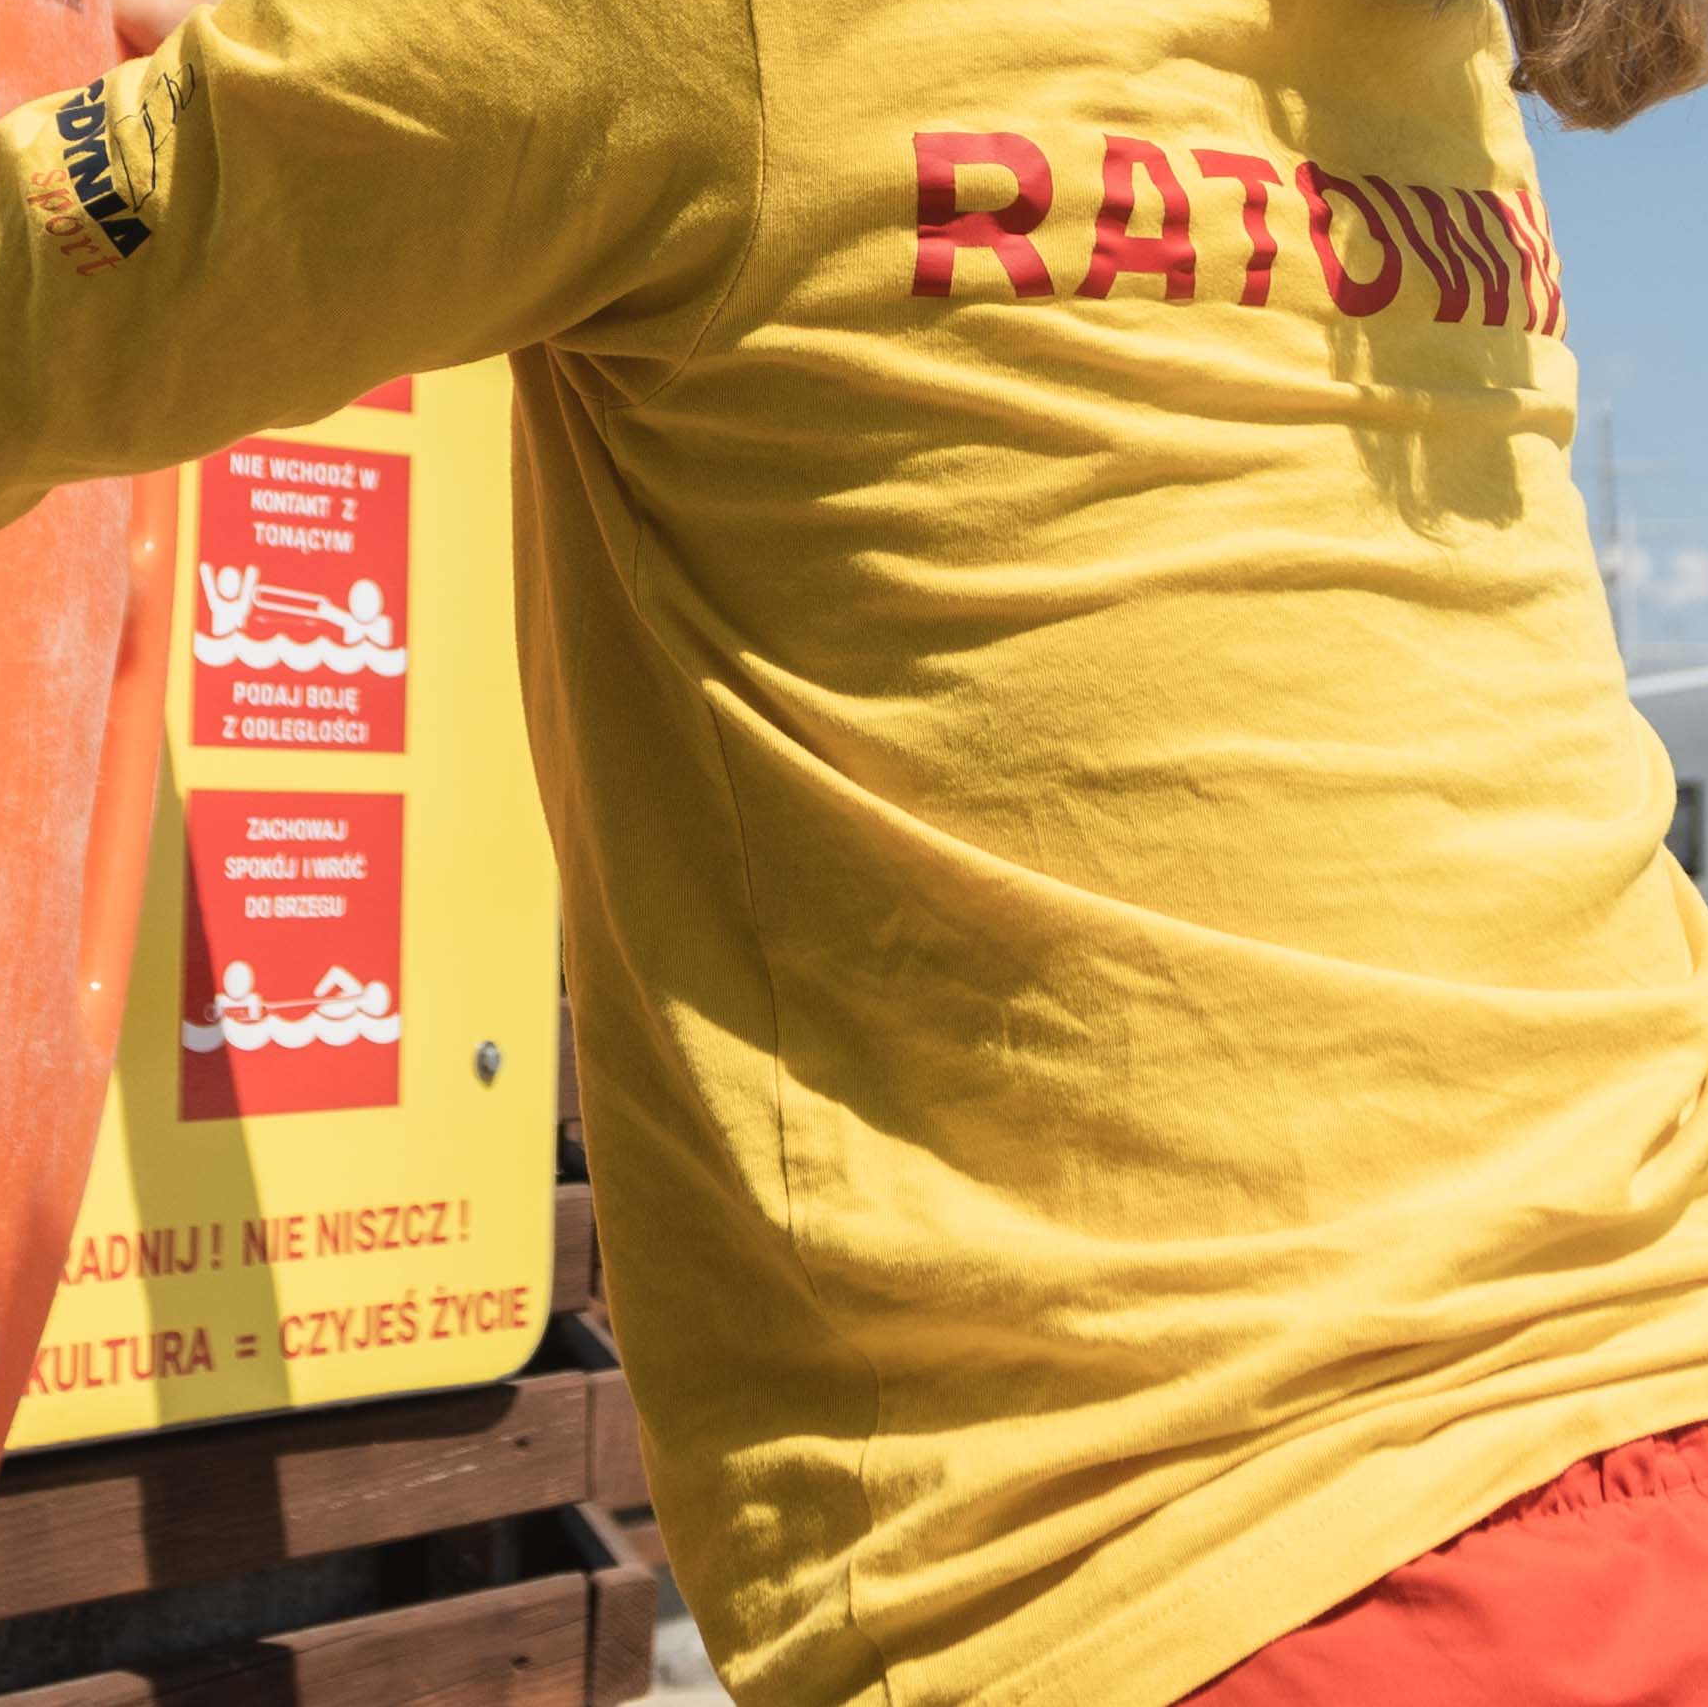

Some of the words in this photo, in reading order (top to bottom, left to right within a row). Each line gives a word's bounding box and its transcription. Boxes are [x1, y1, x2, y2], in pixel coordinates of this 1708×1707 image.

[26, 168, 122, 277] sport
[911, 130, 1566, 342] RATOWN
[229, 452, 265, 479] NIE
[269, 454, 356, 491] WCHODŹ
[359, 466, 380, 491] W
[250, 488, 331, 520] KONTAKT
[341, 496, 358, 522] Z
[252, 521, 354, 555] TONĄCYM
[233, 681, 301, 708] PODAJ
[305, 685, 360, 716] BOJĘ
[222, 715, 238, 741] Z
[240, 716, 369, 745] ODLEGŁOŚCI
[245, 817, 349, 842] ZACHOWAJ
[224, 852, 297, 882] SPOKÓJ
[311, 854, 367, 881] WRÓĆ
[244, 895, 270, 919] DO
[273, 895, 346, 919] BRZEGU
[210, 1221, 222, 1270] !
[242, 1215, 305, 1267] NIE
[316, 1201, 449, 1258] NISZCZ
[459, 1198, 471, 1242] !
[279, 1290, 418, 1361] CZYJEŚ
[430, 1284, 530, 1341] ŻYCIE
